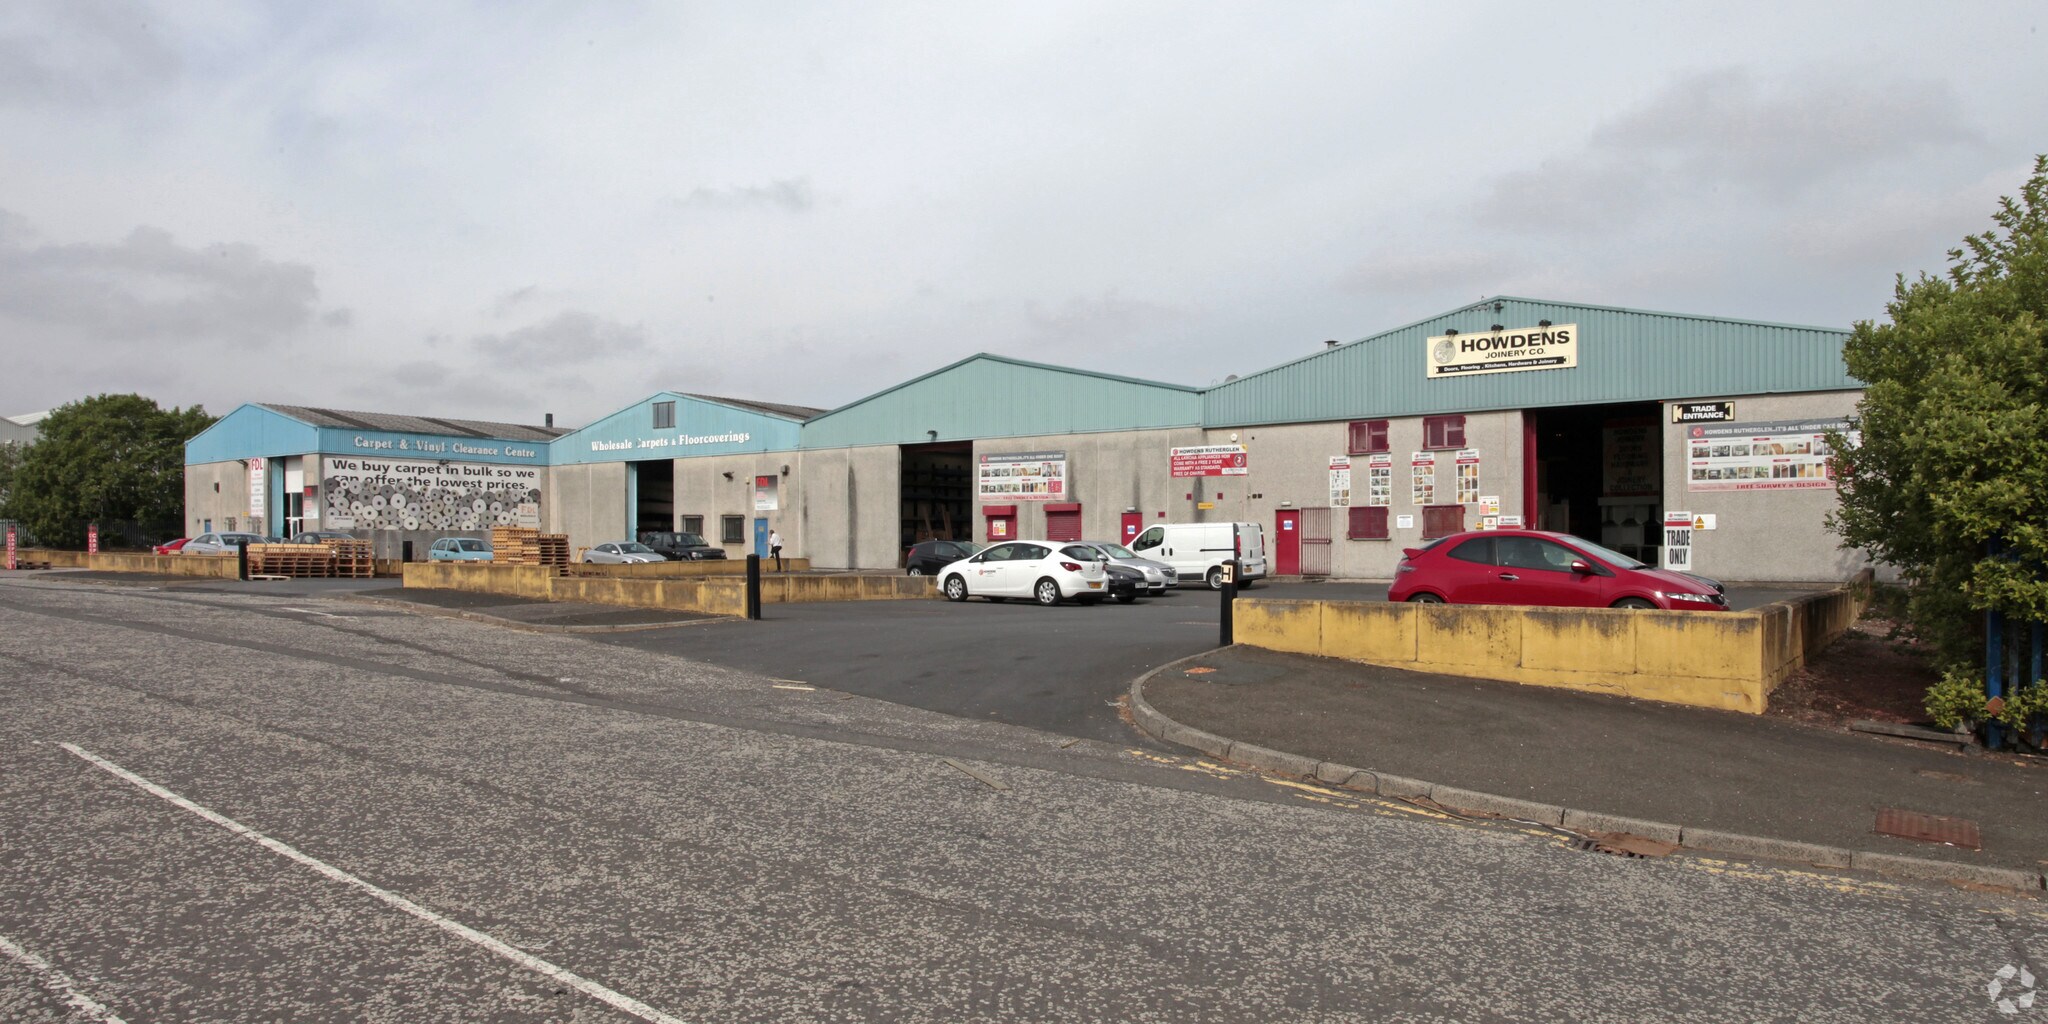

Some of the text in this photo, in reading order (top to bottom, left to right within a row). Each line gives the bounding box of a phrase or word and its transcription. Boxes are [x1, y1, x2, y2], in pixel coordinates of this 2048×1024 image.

[1461, 331, 1570, 352] HOWDENS
[1485, 347, 1546, 359] JOINERY CO.
[1683, 411, 1724, 420] ENTRANCE
[1691, 404, 1717, 412] TRADE
[1800, 423, 1822, 431] UNDER
[354, 436, 536, 458] Carpet & Vinyl Clearance Centre
[591, 438, 633, 451] Wholesale
[679, 430, 750, 444] Floorcoverings
[251, 458, 263, 470] FDL
[333, 459, 357, 470] We
[361, 461, 390, 474] buy
[395, 464, 441, 476] carpet
[446, 465, 459, 475] in
[463, 466, 493, 477] bulk
[497, 469, 512, 478] so
[364, 475, 403, 486] offer
[406, 476, 431, 487] the
[436, 477, 483, 489] lowest
[487, 480, 529, 491] prices.
[1666, 529, 1690, 546] TRADE
[1669, 548, 1687, 564] ONLY
[1221, 566, 1231, 581] H
